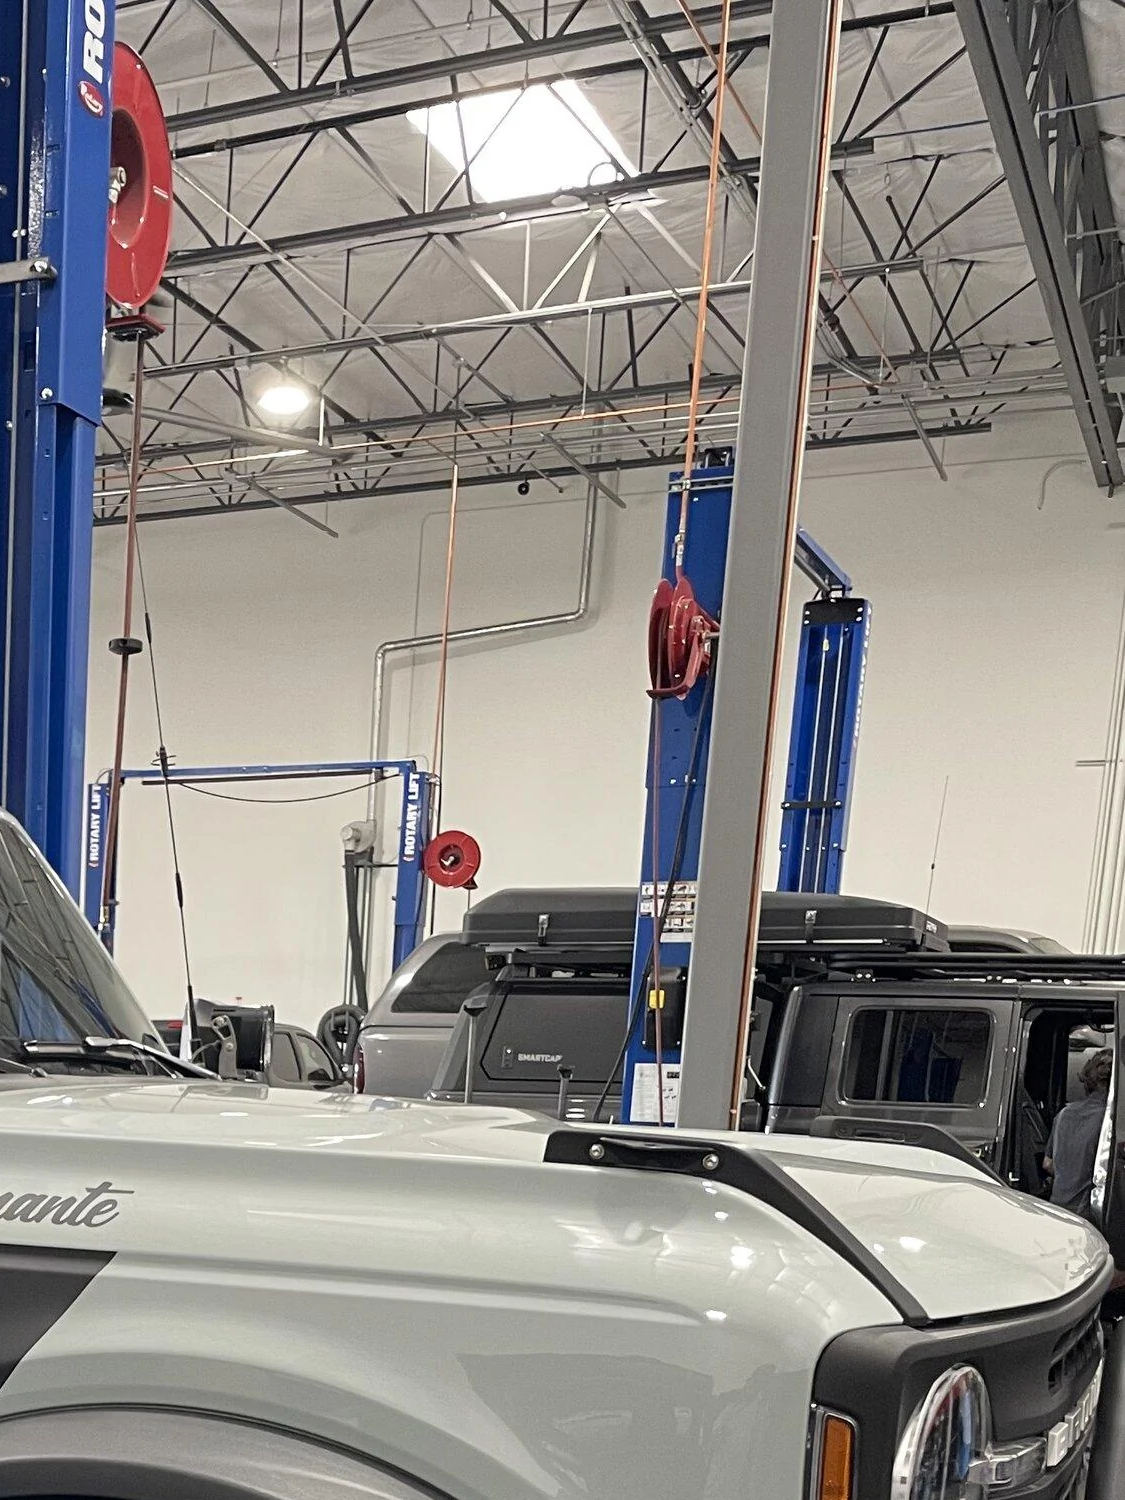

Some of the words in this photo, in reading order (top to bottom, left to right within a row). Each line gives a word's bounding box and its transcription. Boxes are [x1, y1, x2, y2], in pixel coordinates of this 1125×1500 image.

[91, 784, 102, 810] LIFT
[407, 772, 420, 800] LIFT
[89, 812, 101, 862] ROTARY
[403, 803, 417, 855] ROTARY
[517, 1053, 563, 1063] SMARTCAP
